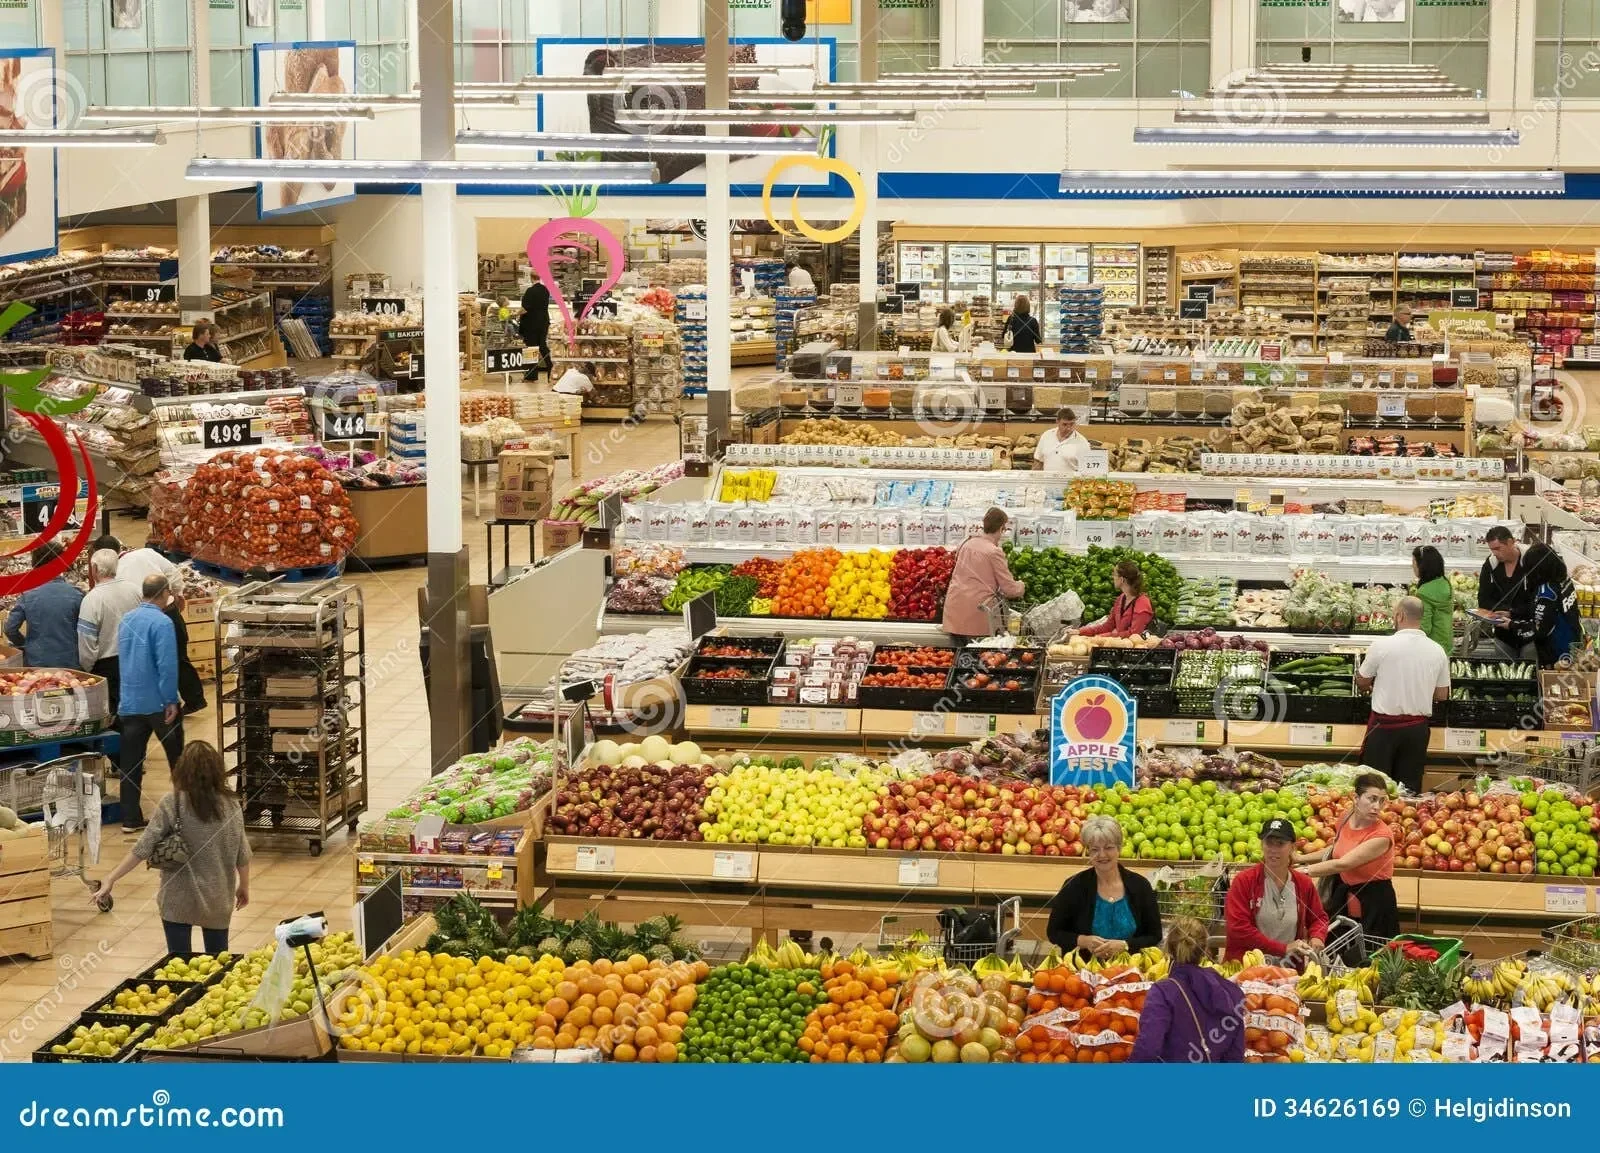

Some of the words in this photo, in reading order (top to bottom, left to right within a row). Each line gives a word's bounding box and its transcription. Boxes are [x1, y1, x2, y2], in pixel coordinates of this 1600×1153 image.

[144, 288, 161, 302] .97
[501, 352, 523, 369] 5.00
[209, 423, 242, 444] 4.98
[333, 416, 364, 436] 4.48
[1086, 534, 1102, 543] 6.99
[1067, 744, 1120, 758] APPLE
[1067, 757, 1117, 772] FEST
